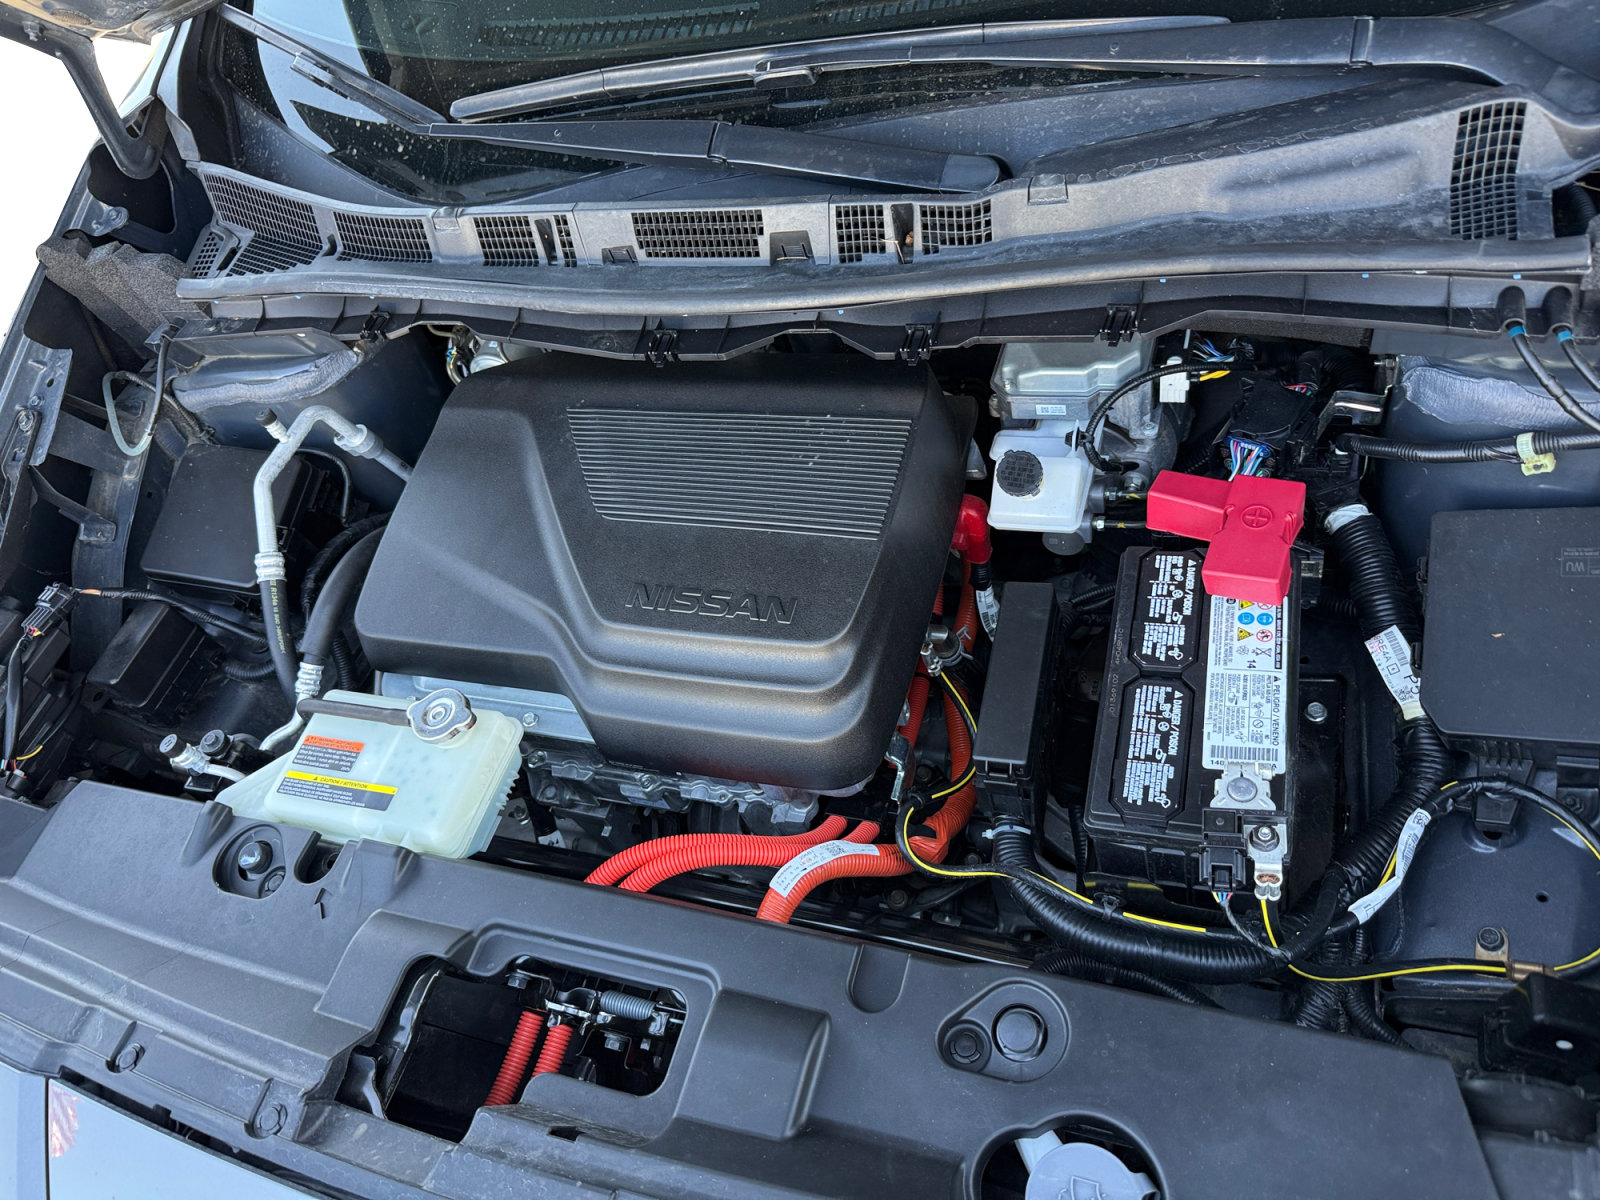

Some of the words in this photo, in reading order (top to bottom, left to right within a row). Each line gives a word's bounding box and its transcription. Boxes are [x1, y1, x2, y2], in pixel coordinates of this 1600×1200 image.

[625, 582, 798, 625] NISSAN
[1247, 660, 1256, 669] 14
[1272, 719, 1280, 746] VENENO
